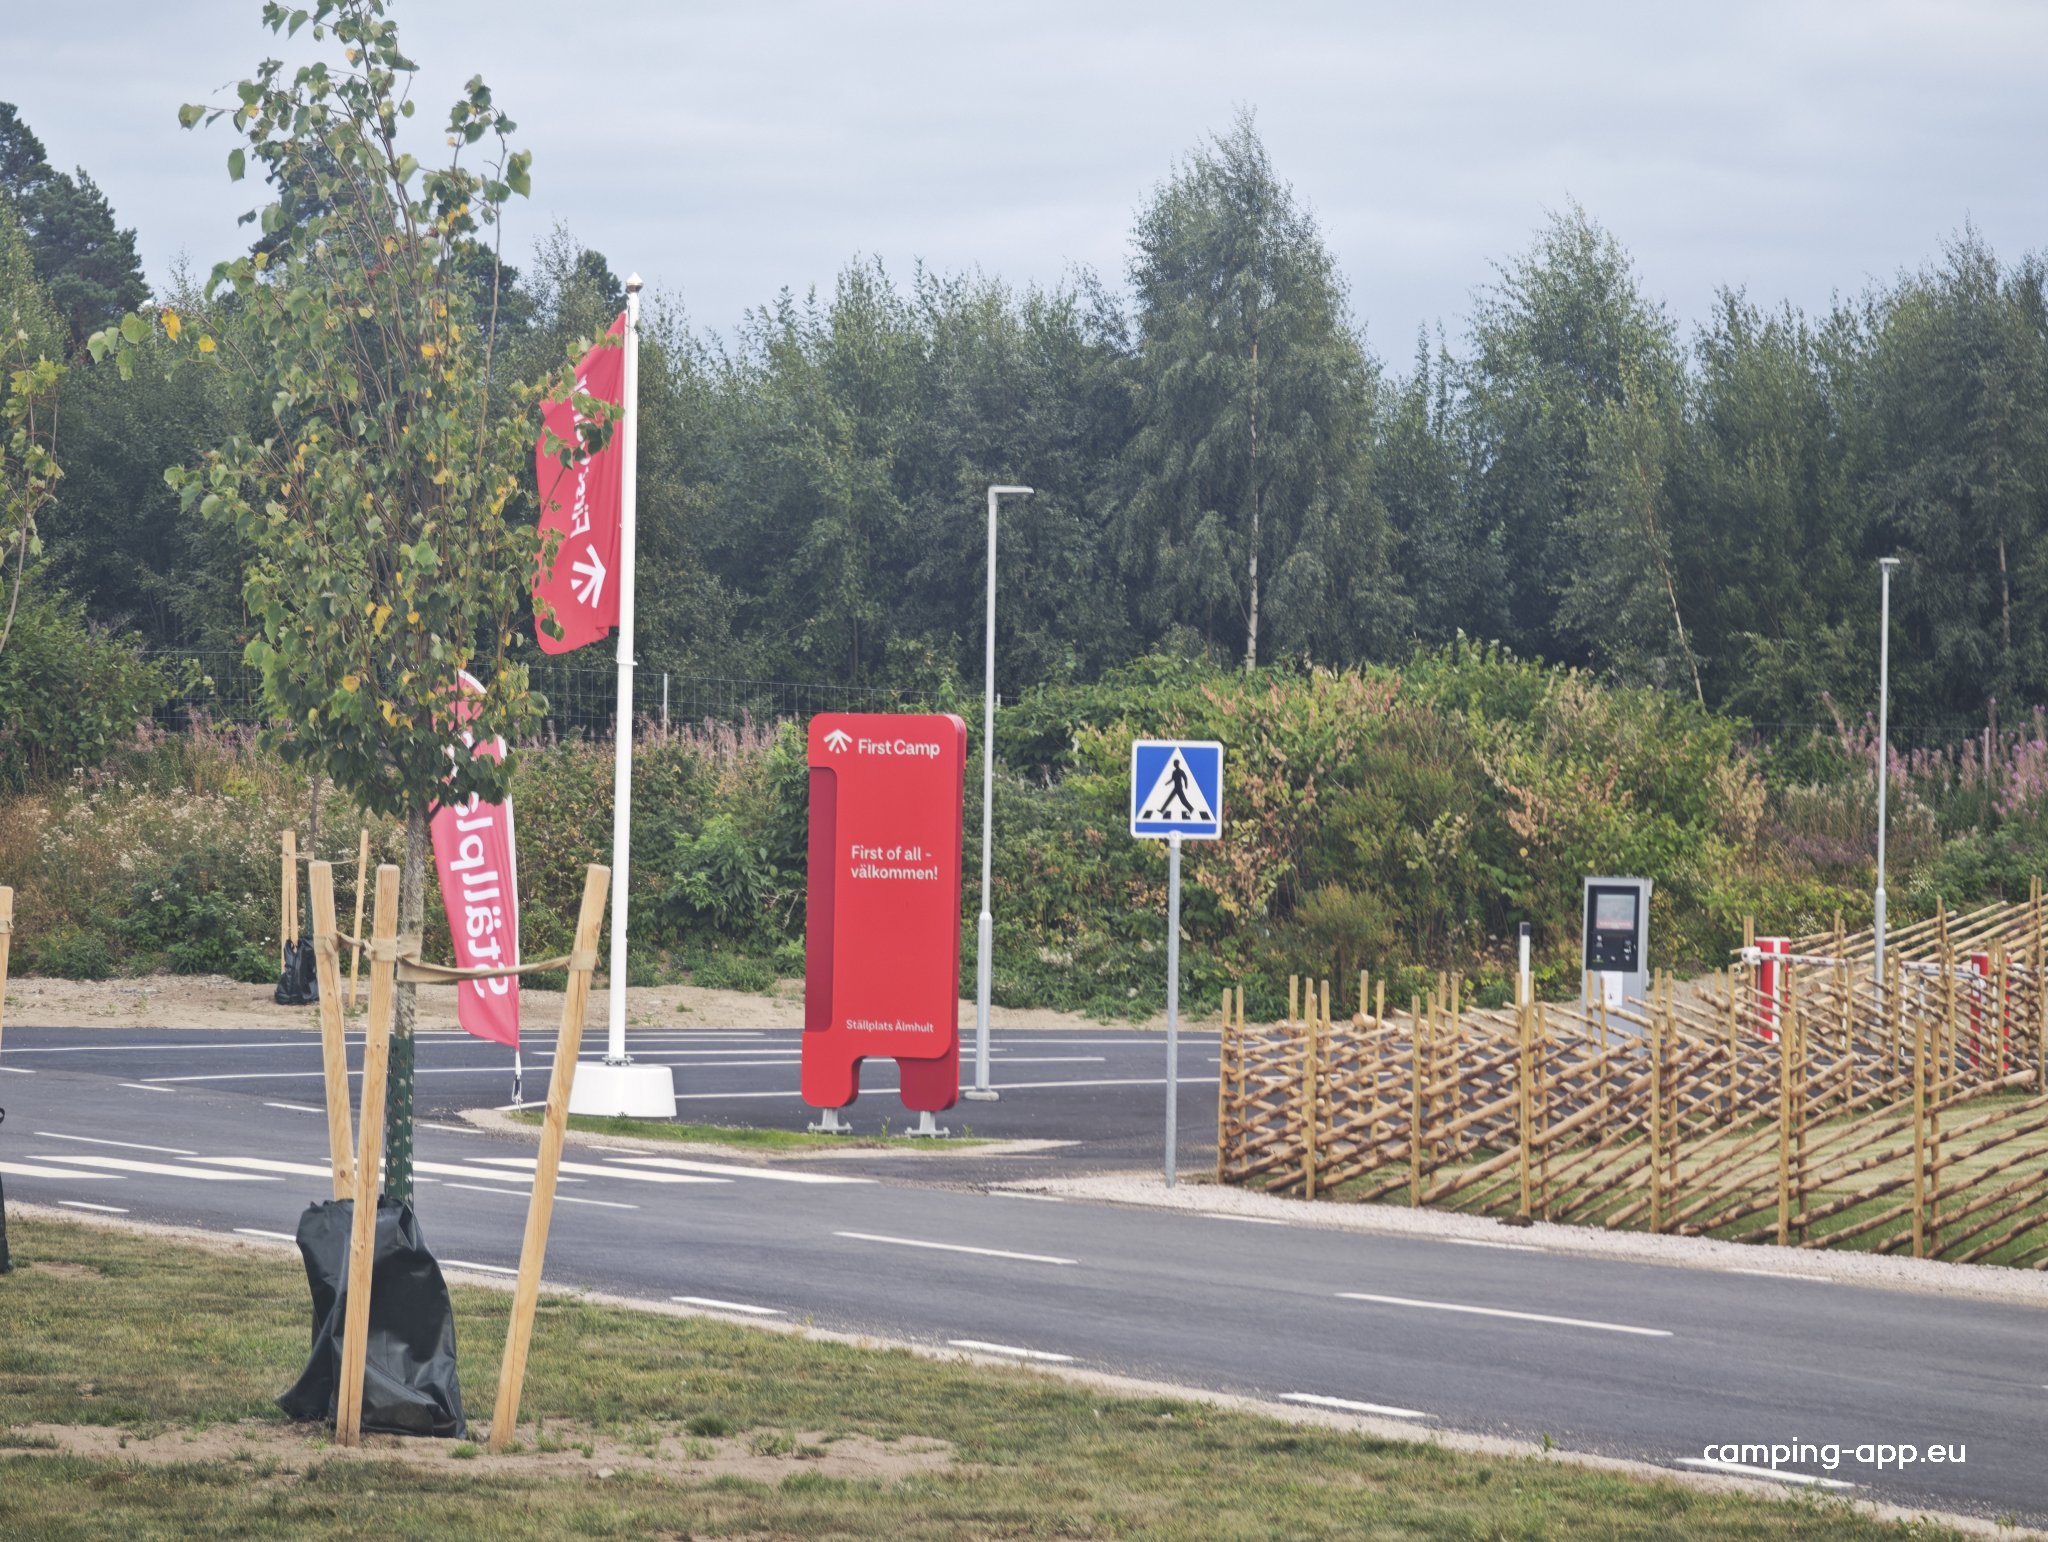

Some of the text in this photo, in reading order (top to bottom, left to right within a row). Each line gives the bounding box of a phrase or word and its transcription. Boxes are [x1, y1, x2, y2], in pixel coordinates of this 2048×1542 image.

[858, 738, 939, 758] First Camp
[851, 844, 883, 861] First
[886, 845, 902, 861] of
[904, 846, 922, 862] all
[850, 863, 937, 880] välkommen!
[846, 1018, 934, 1033] Ställplats Älmhult
